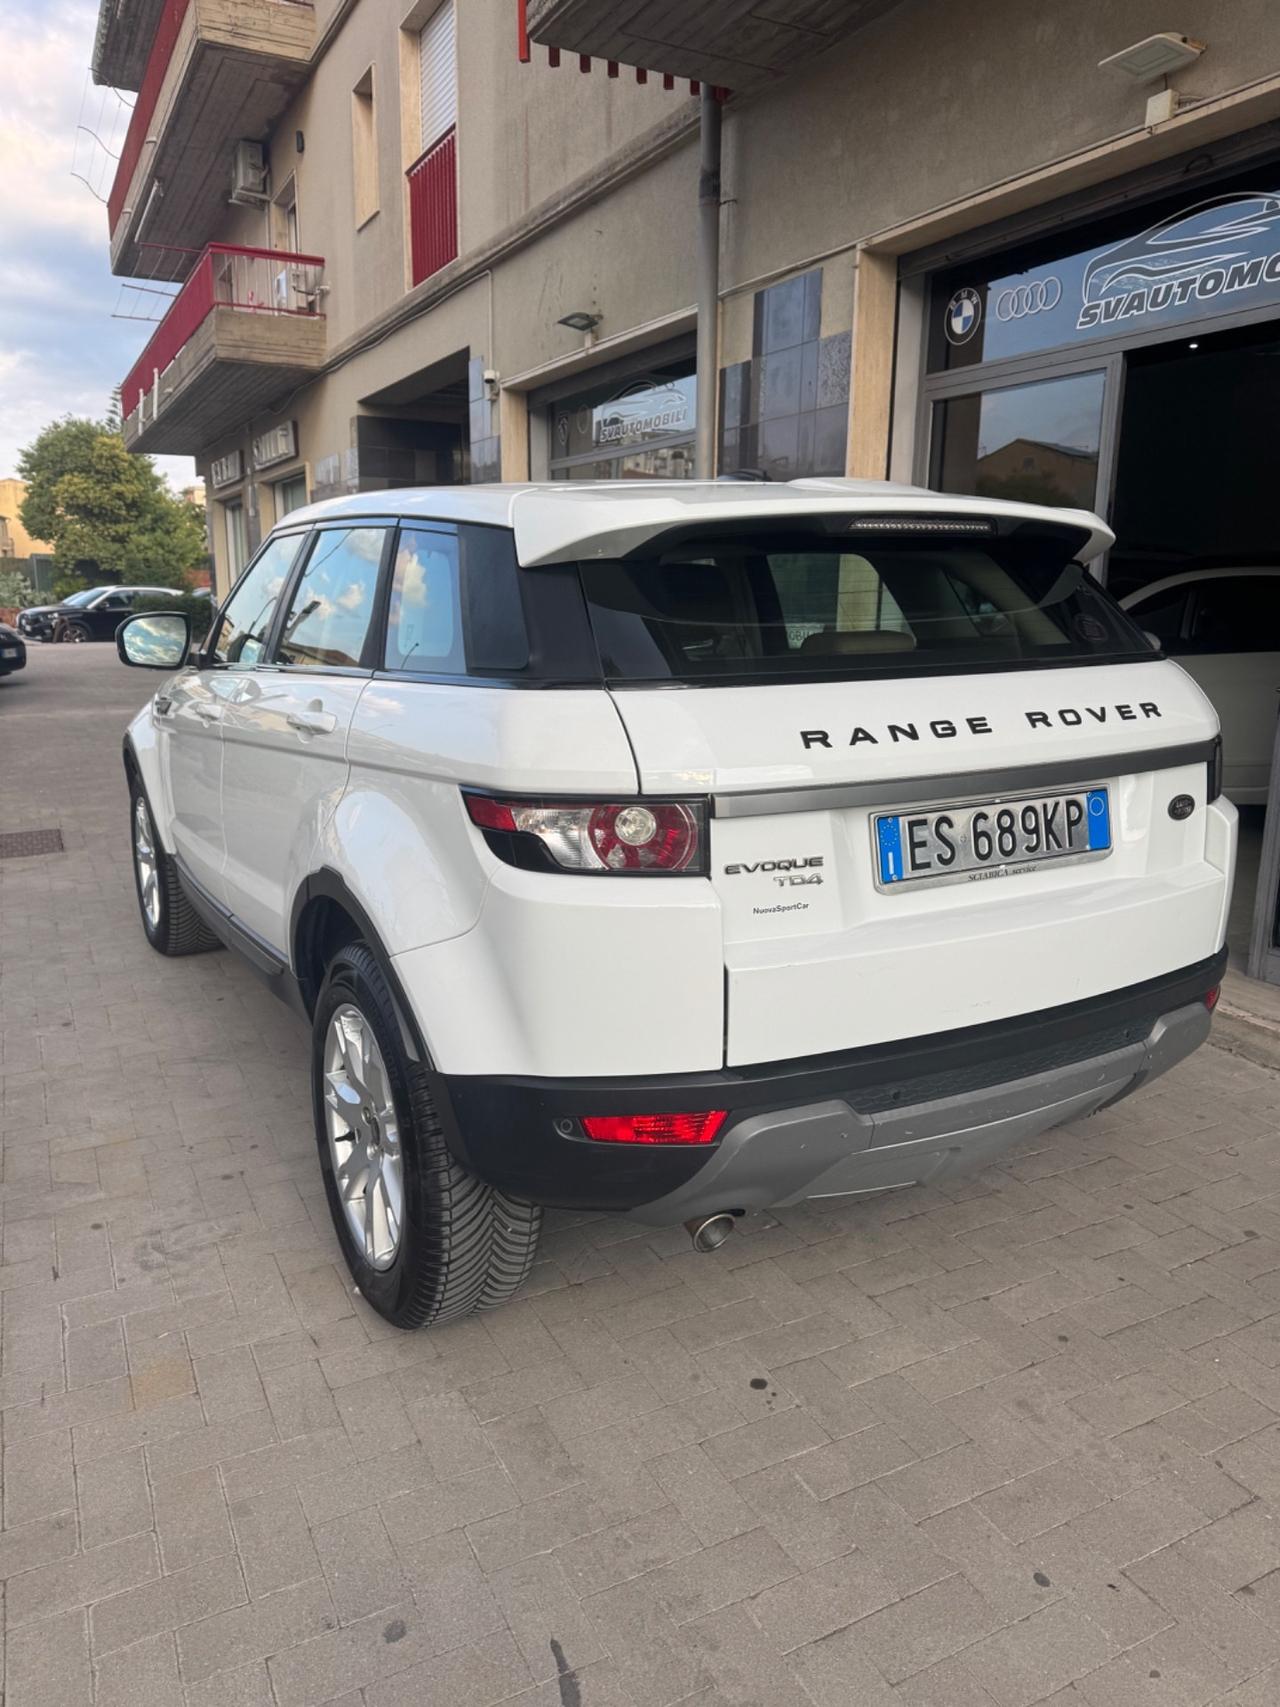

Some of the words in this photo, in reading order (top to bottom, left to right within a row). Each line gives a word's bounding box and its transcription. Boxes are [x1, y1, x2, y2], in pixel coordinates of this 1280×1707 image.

[600, 408, 688, 441] SVAUTOMOBILI
[800, 716, 993, 749] RANGE
[1024, 702, 1162, 729] ROVER
[906, 815, 957, 872] ES
[971, 799, 1084, 861] 689KP
[724, 856, 824, 875] EVOQUE
[772, 873, 824, 887] TD4
[752, 902, 810, 915] NuovaSportCar
